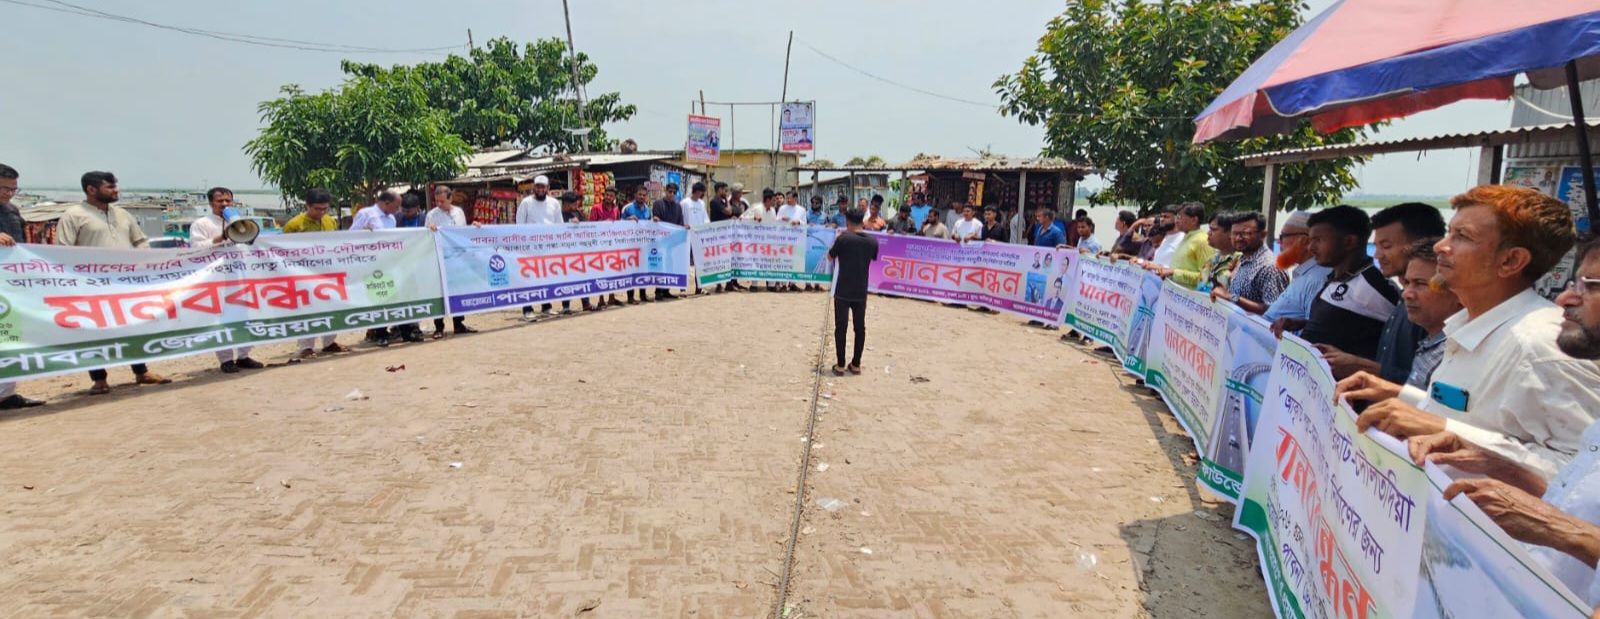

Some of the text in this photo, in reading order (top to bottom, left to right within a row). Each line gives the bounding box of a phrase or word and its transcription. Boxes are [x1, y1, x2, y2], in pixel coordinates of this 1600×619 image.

[2, 259, 65, 274] বাসীর
[73, 261, 136, 274] প্রাণের
[146, 257, 183, 272] দাবি
[516, 247, 641, 279] মানববন্ধন
[881, 255, 1023, 296] মানববন্ধন
[6, 277, 78, 288] আকারে
[86, 277, 112, 288] ২য়
[496, 287, 549, 304] পাবনা
[554, 281, 592, 296] জেলা
[596, 276, 633, 291] উন্নয়ন
[635, 274, 680, 287] ফোরাম
[43, 271, 348, 329] মানববন্ধন
[0, 302, 434, 371] পাবনা জেলা উন্নয়ন ফোরাম
